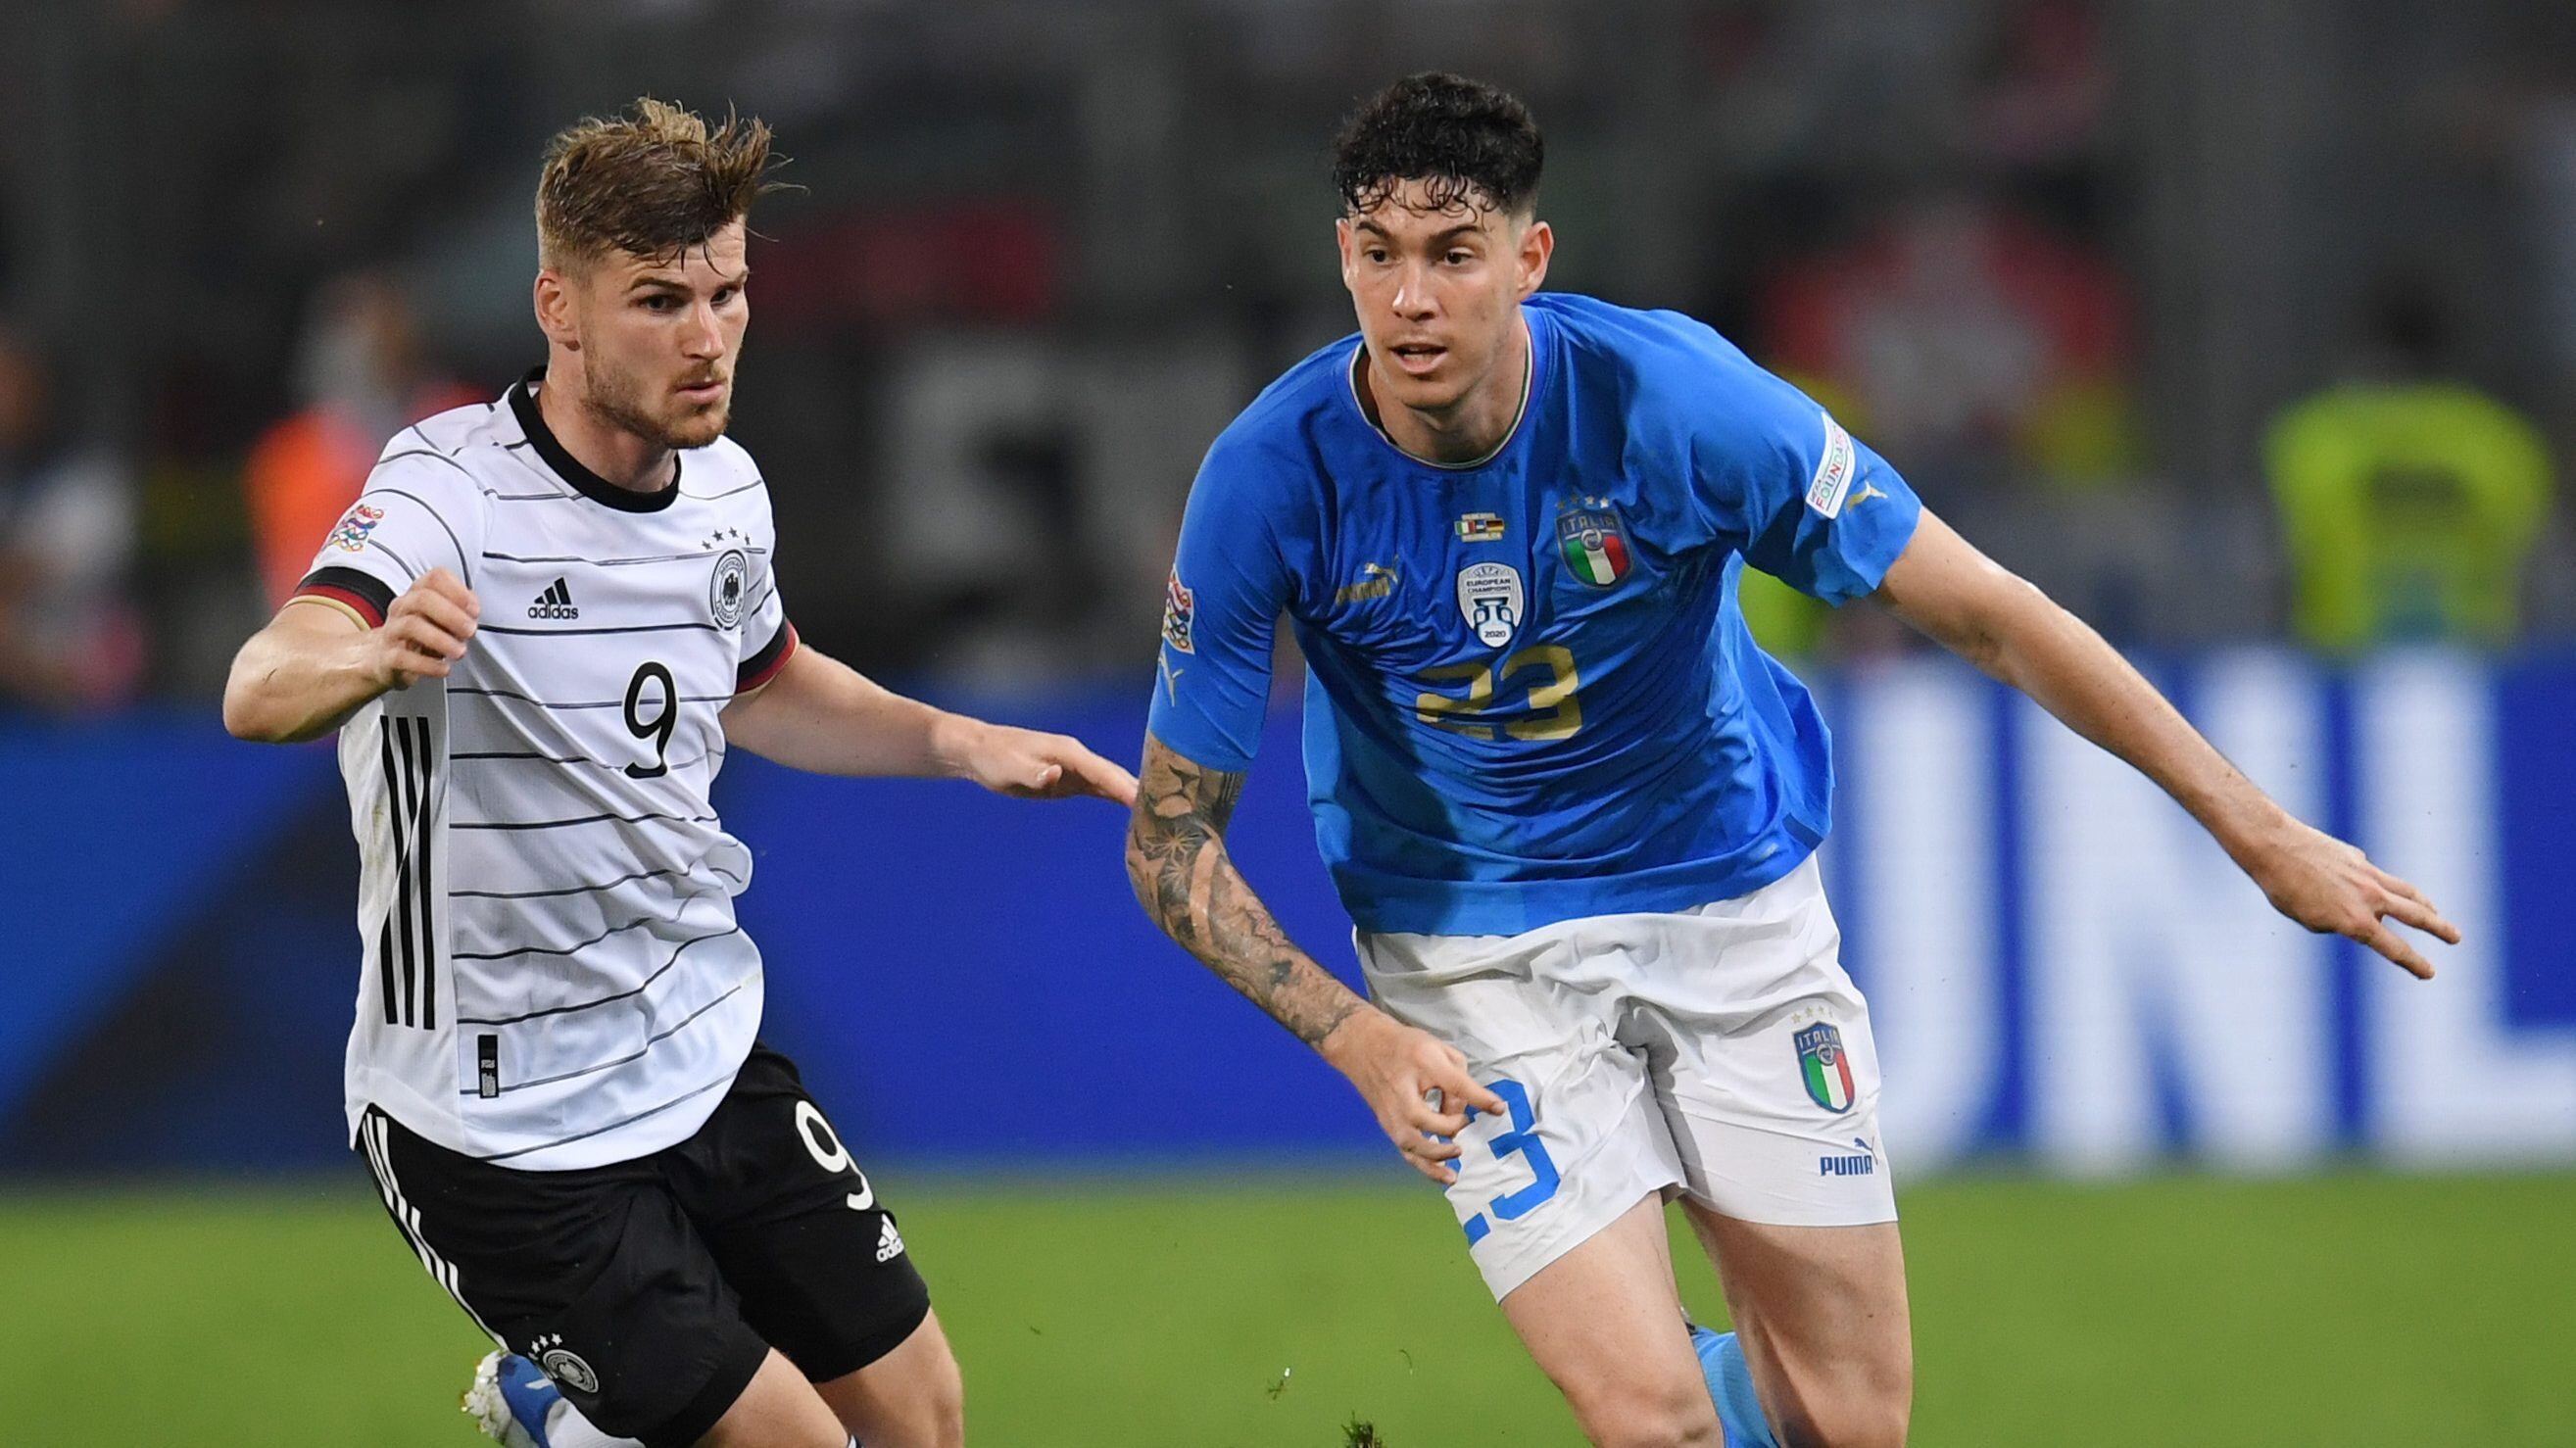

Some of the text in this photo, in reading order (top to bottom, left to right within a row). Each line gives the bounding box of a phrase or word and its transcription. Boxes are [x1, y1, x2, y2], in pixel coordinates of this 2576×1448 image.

[1563, 513, 1617, 534] ITALIA
[1467, 578, 1511, 587] EUROPEAN
[528, 603, 579, 619] adidas
[1416, 645, 1583, 741] 23
[622, 660, 678, 780] 9
[1799, 1027, 1841, 1049] ITALIA
[796, 1099, 874, 1211] 9
[1821, 1155, 1873, 1176] PUMA
